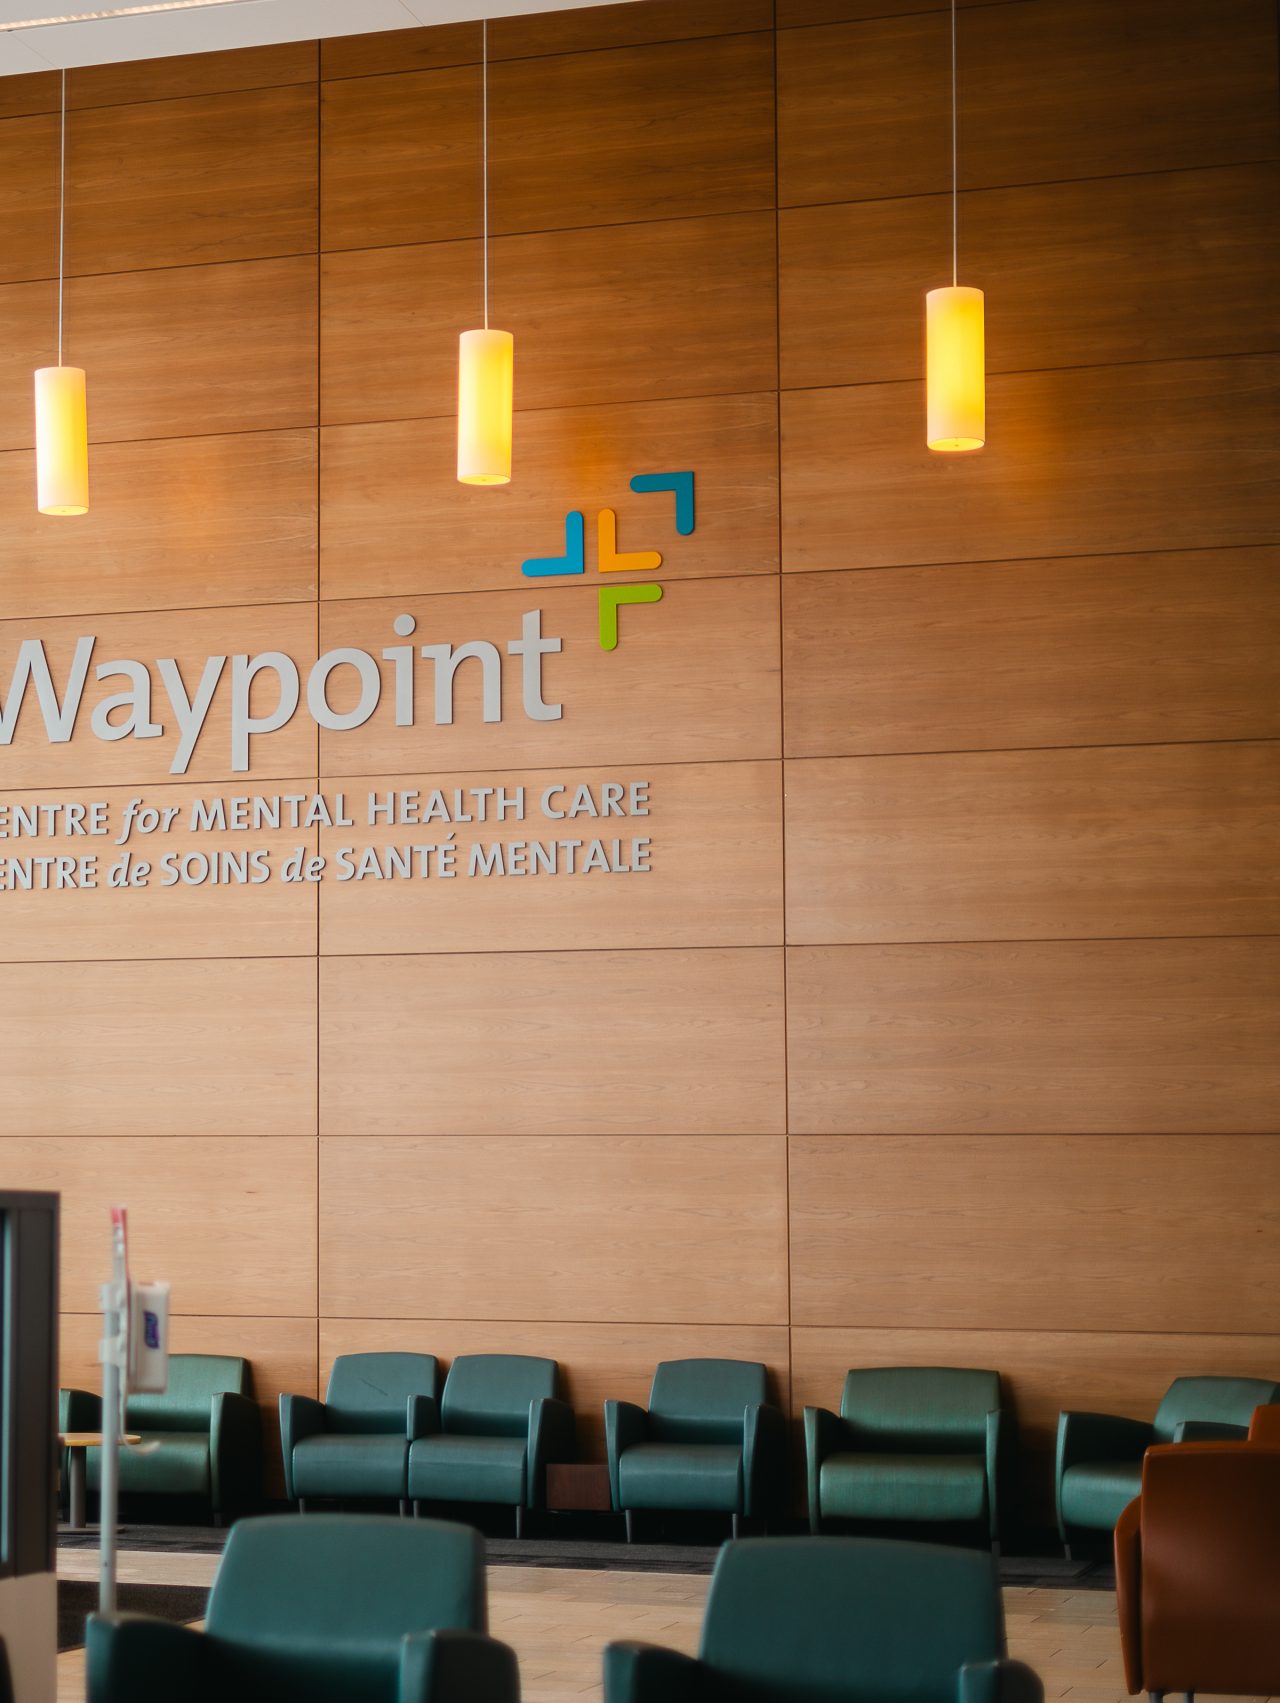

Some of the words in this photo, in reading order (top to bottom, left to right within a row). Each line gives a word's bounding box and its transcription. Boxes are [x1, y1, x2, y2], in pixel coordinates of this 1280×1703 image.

[116, 799, 179, 845] for
[190, 794, 353, 831] MENTAL
[367, 787, 525, 824] HEALTH
[541, 782, 651, 820] CARE
[108, 853, 149, 888] de
[160, 850, 270, 886] SOINS
[281, 847, 324, 882] de
[336, 833, 456, 881] SANTÉ
[468, 838, 650, 876] MENTALE
